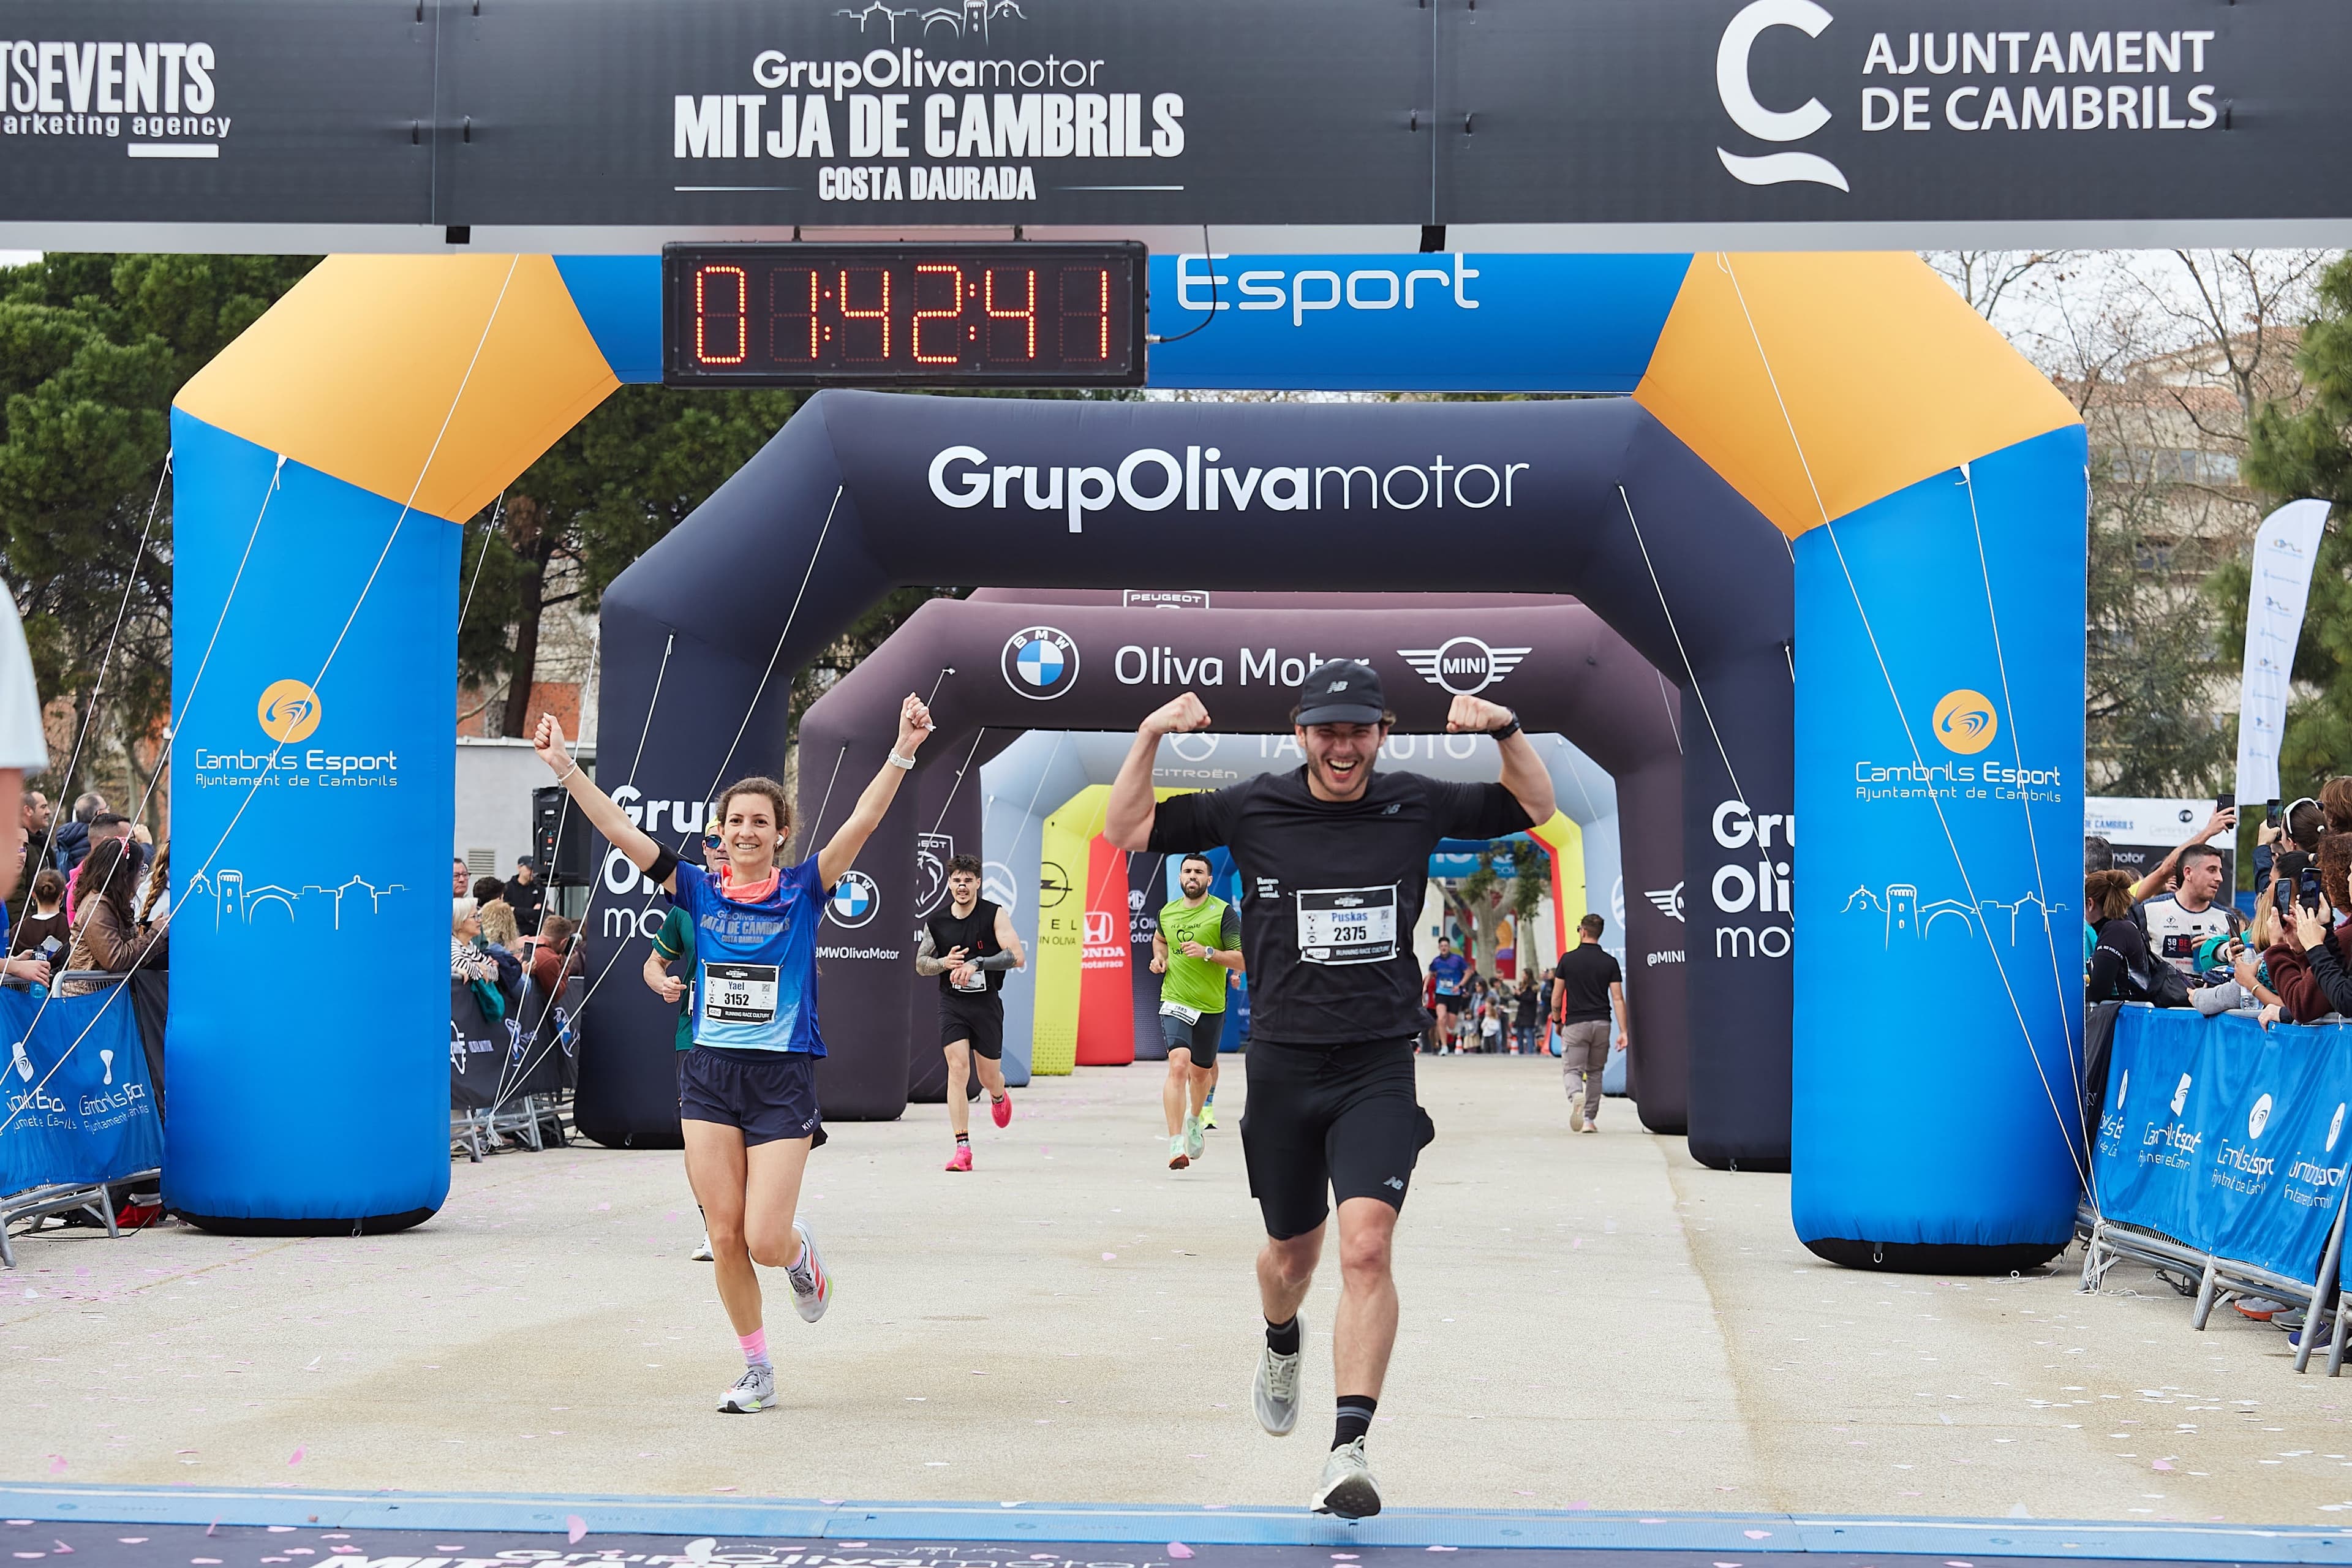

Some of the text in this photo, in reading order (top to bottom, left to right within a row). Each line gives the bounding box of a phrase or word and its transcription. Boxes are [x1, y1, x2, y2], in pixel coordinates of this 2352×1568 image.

[1862, 31, 2215, 75] AJUNTAMENT
[753, 47, 1105, 101] GrupOlivamotor
[1861, 85, 2218, 132] DE CAMBRILS
[0, 113, 232, 138] arketing agency
[674, 92, 1185, 159] MITJA DE CAMBRILS
[819, 165, 1036, 201] COSTA DAURADA
[1177, 252, 1480, 327] Esport
[927, 445, 1530, 533] GrupOlivamotor
[1131, 594, 1202, 603] PEUGEOT
[1012, 629, 1070, 650] BMW
[1114, 646, 1370, 687] Oliva Mot
[1442, 657, 1487, 674] MINI
[195, 748, 398, 776] Cambrils Esport
[1855, 760, 2061, 790] Cambrils Esport
[195, 773, 398, 789] Ajuntament de Cambrils
[1856, 786, 2062, 804] Ajuntament de Cambrils
[610, 785, 717, 834] Gru
[1711, 861, 1795, 914] Oli
[726, 921, 740, 935] DE
[1332, 911, 1368, 922] Puskas
[721, 935, 737, 943] COSTA
[1052, 936, 1076, 945] OLIVA
[1334, 925, 1367, 941] 2375
[1716, 926, 1795, 959] mo
[728, 981, 745, 990] Yael
[724, 993, 749, 1006] 3152
